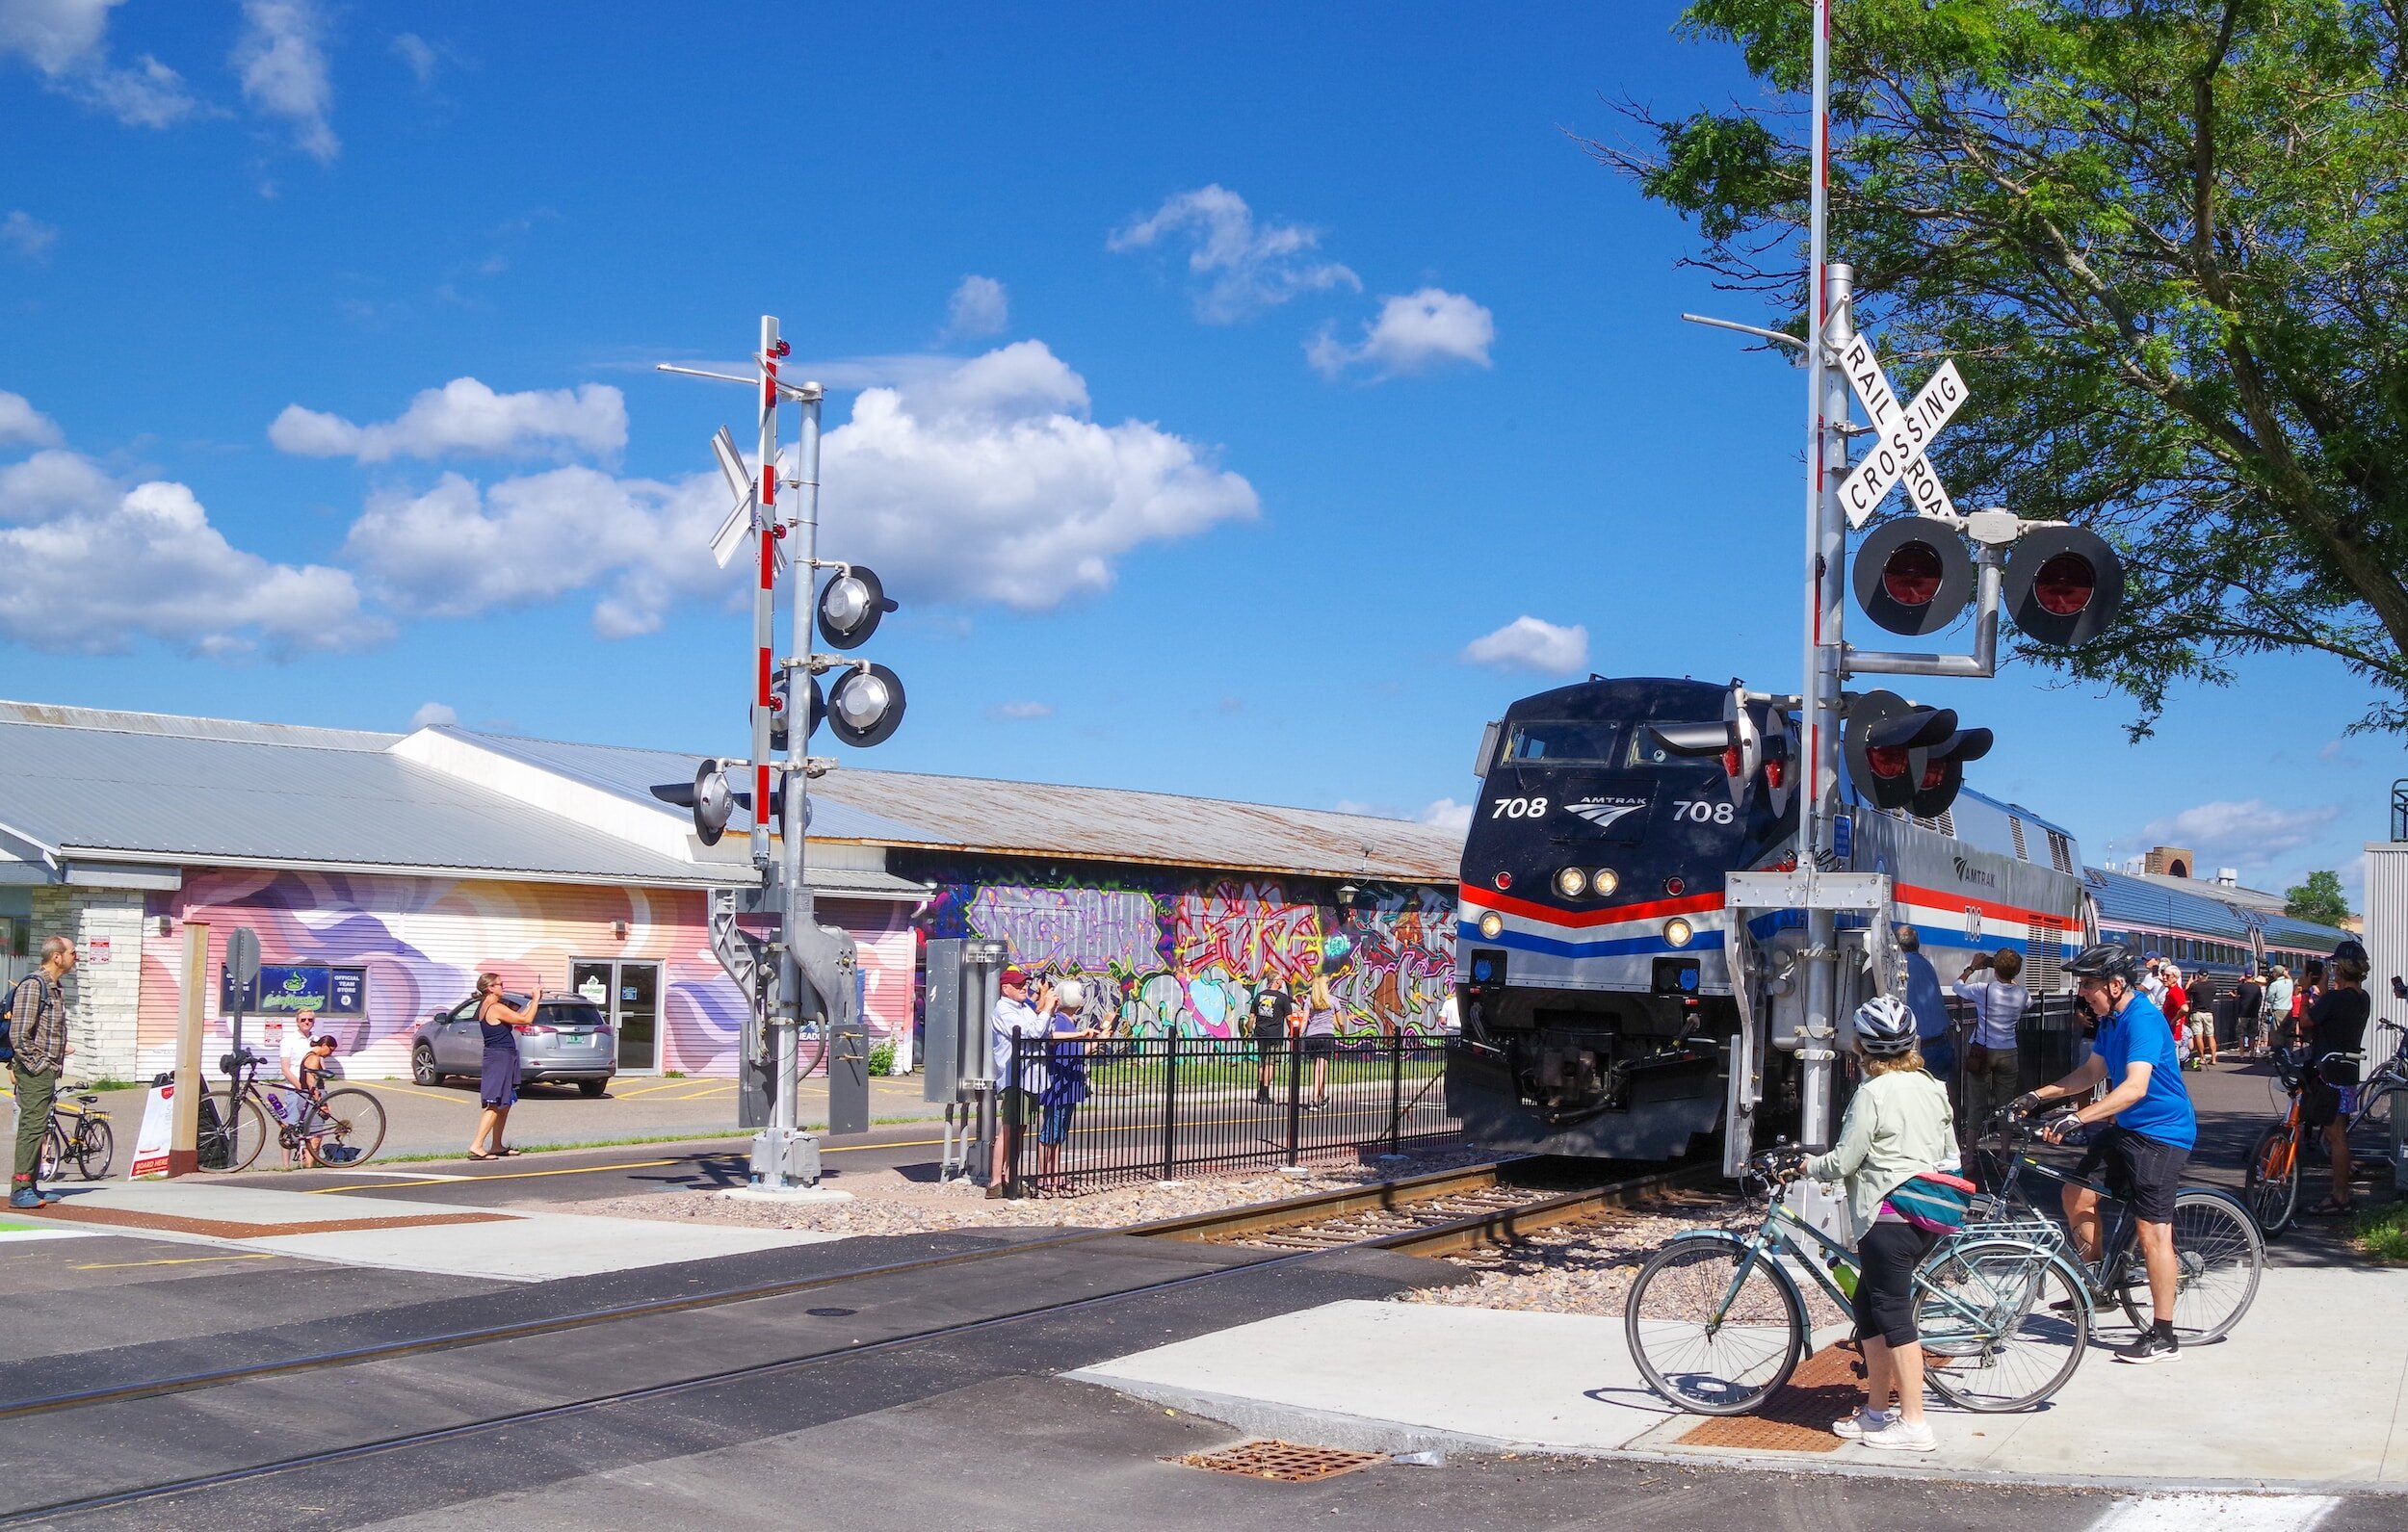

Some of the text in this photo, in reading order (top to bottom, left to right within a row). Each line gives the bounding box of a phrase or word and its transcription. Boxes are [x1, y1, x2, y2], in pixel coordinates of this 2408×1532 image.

[1846, 344, 1951, 517] RAIL ROA
[1850, 377, 1957, 510] CROSSING
[1492, 797, 1549, 819] 708
[1580, 796, 1648, 806] AMTRAK
[1672, 800, 1735, 825] 708
[1965, 868, 1995, 888] AMTRAK
[1965, 904, 1981, 942] 708
[136, 1160, 154, 1170] BOARD
